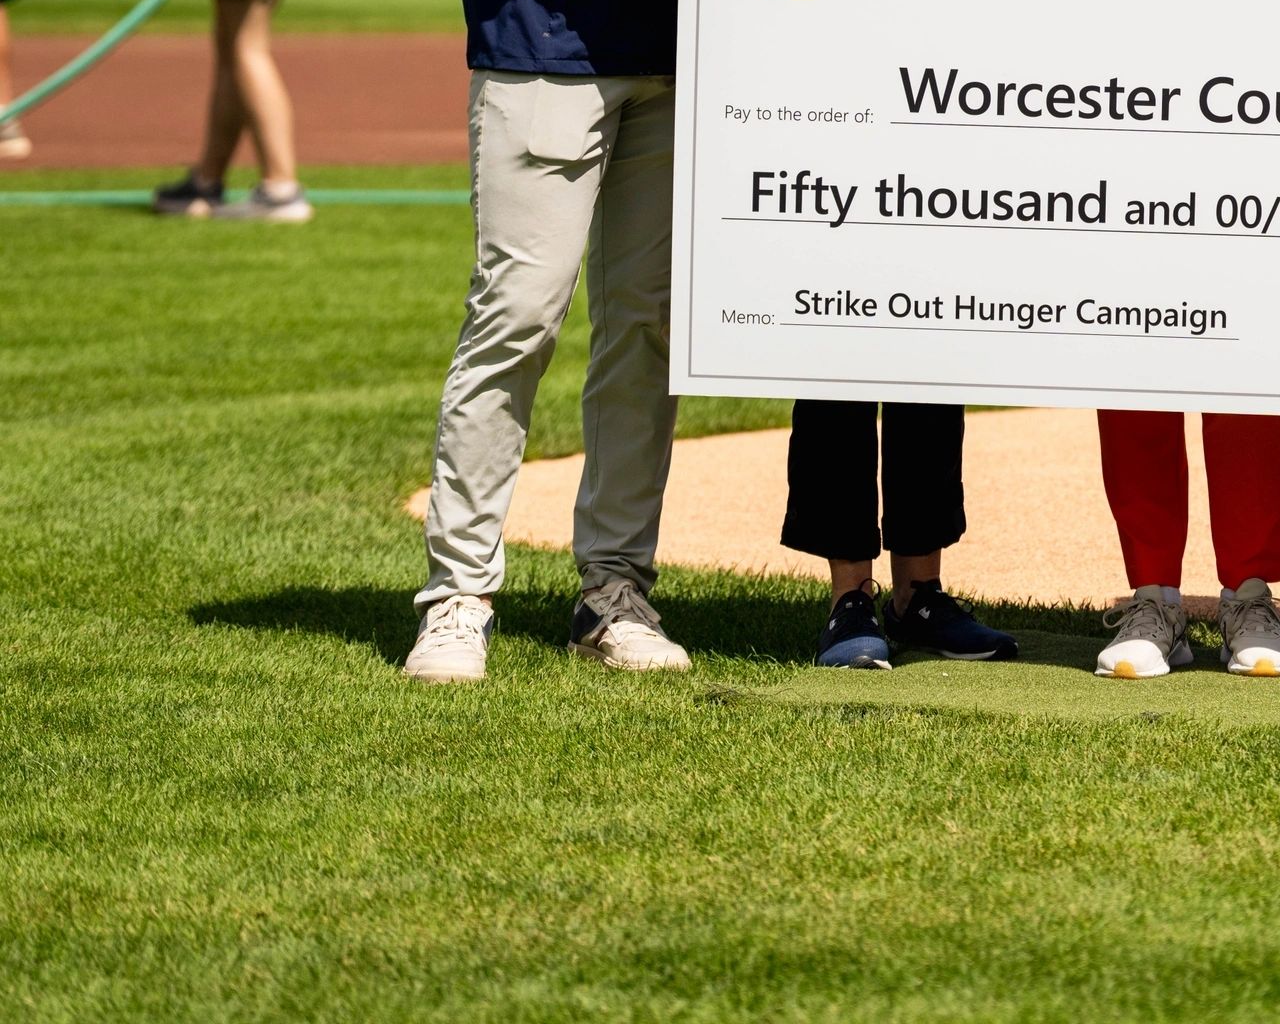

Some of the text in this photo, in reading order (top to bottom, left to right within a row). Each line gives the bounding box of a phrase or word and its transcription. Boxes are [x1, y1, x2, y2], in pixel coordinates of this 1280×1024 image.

[725, 105, 873, 123] Pay to the order of:
[899, 67, 1181, 121] Worcester
[750, 170, 858, 228] Fifty
[876, 174, 1107, 223] thousand
[1125, 192, 1195, 226] and
[722, 309, 774, 325] Memo:
[795, 290, 1227, 335] Strike Out Hunger Campaign
